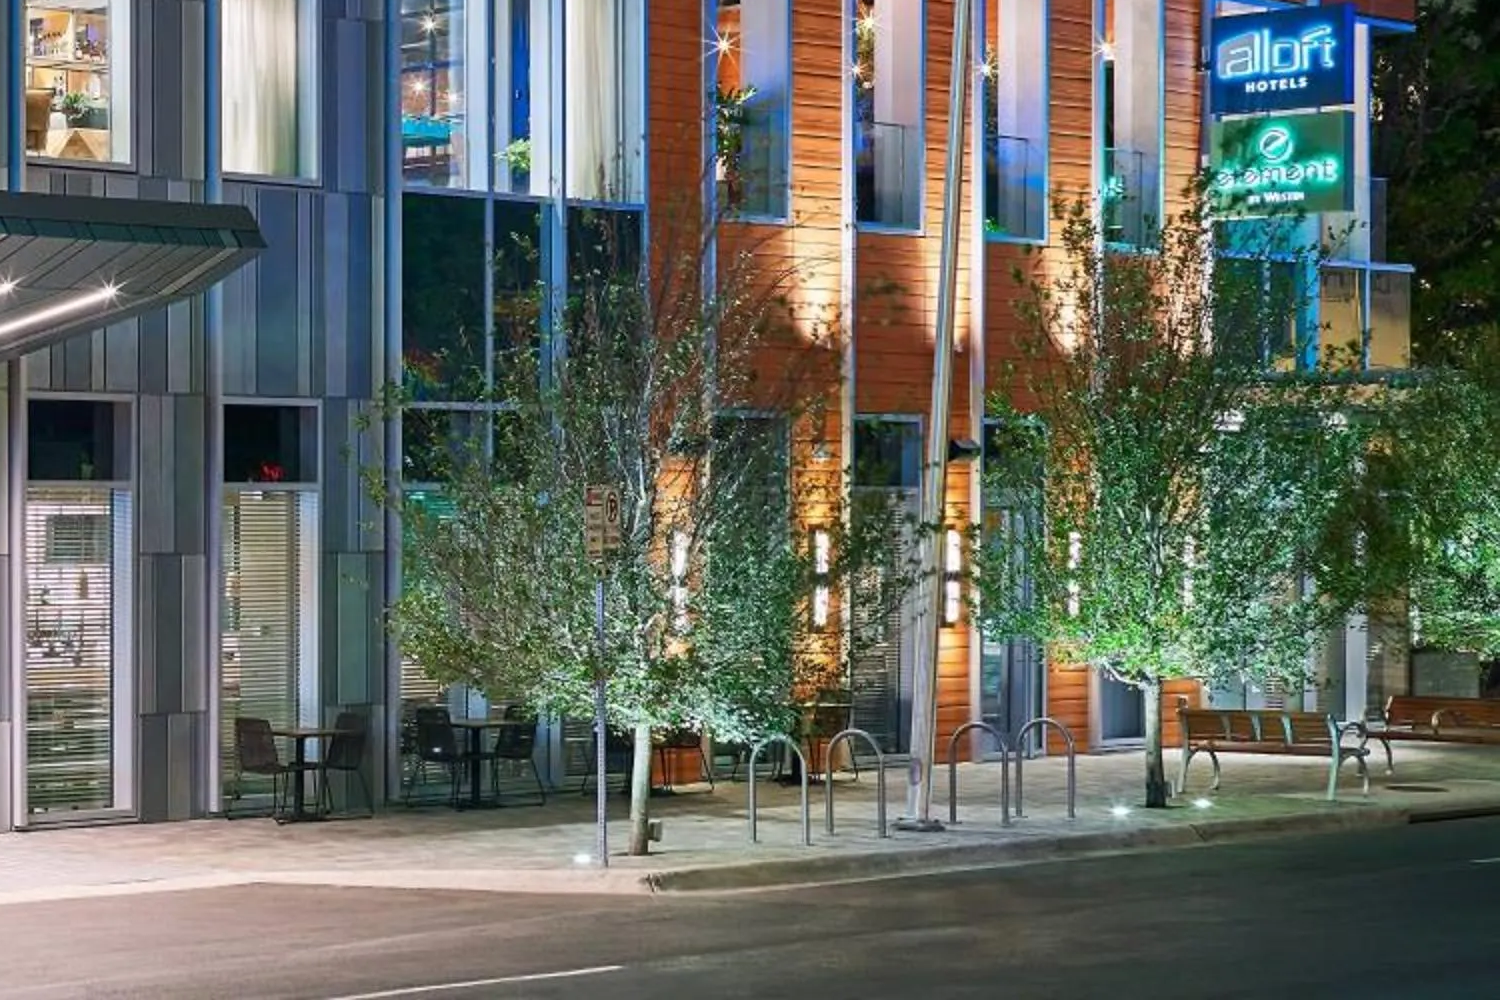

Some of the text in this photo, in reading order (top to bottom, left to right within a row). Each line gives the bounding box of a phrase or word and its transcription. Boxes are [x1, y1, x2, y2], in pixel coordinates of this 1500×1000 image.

[1217, 25, 1336, 79] aloft
[1245, 77, 1308, 93] HOTELS
[1216, 158, 1338, 189] eement
